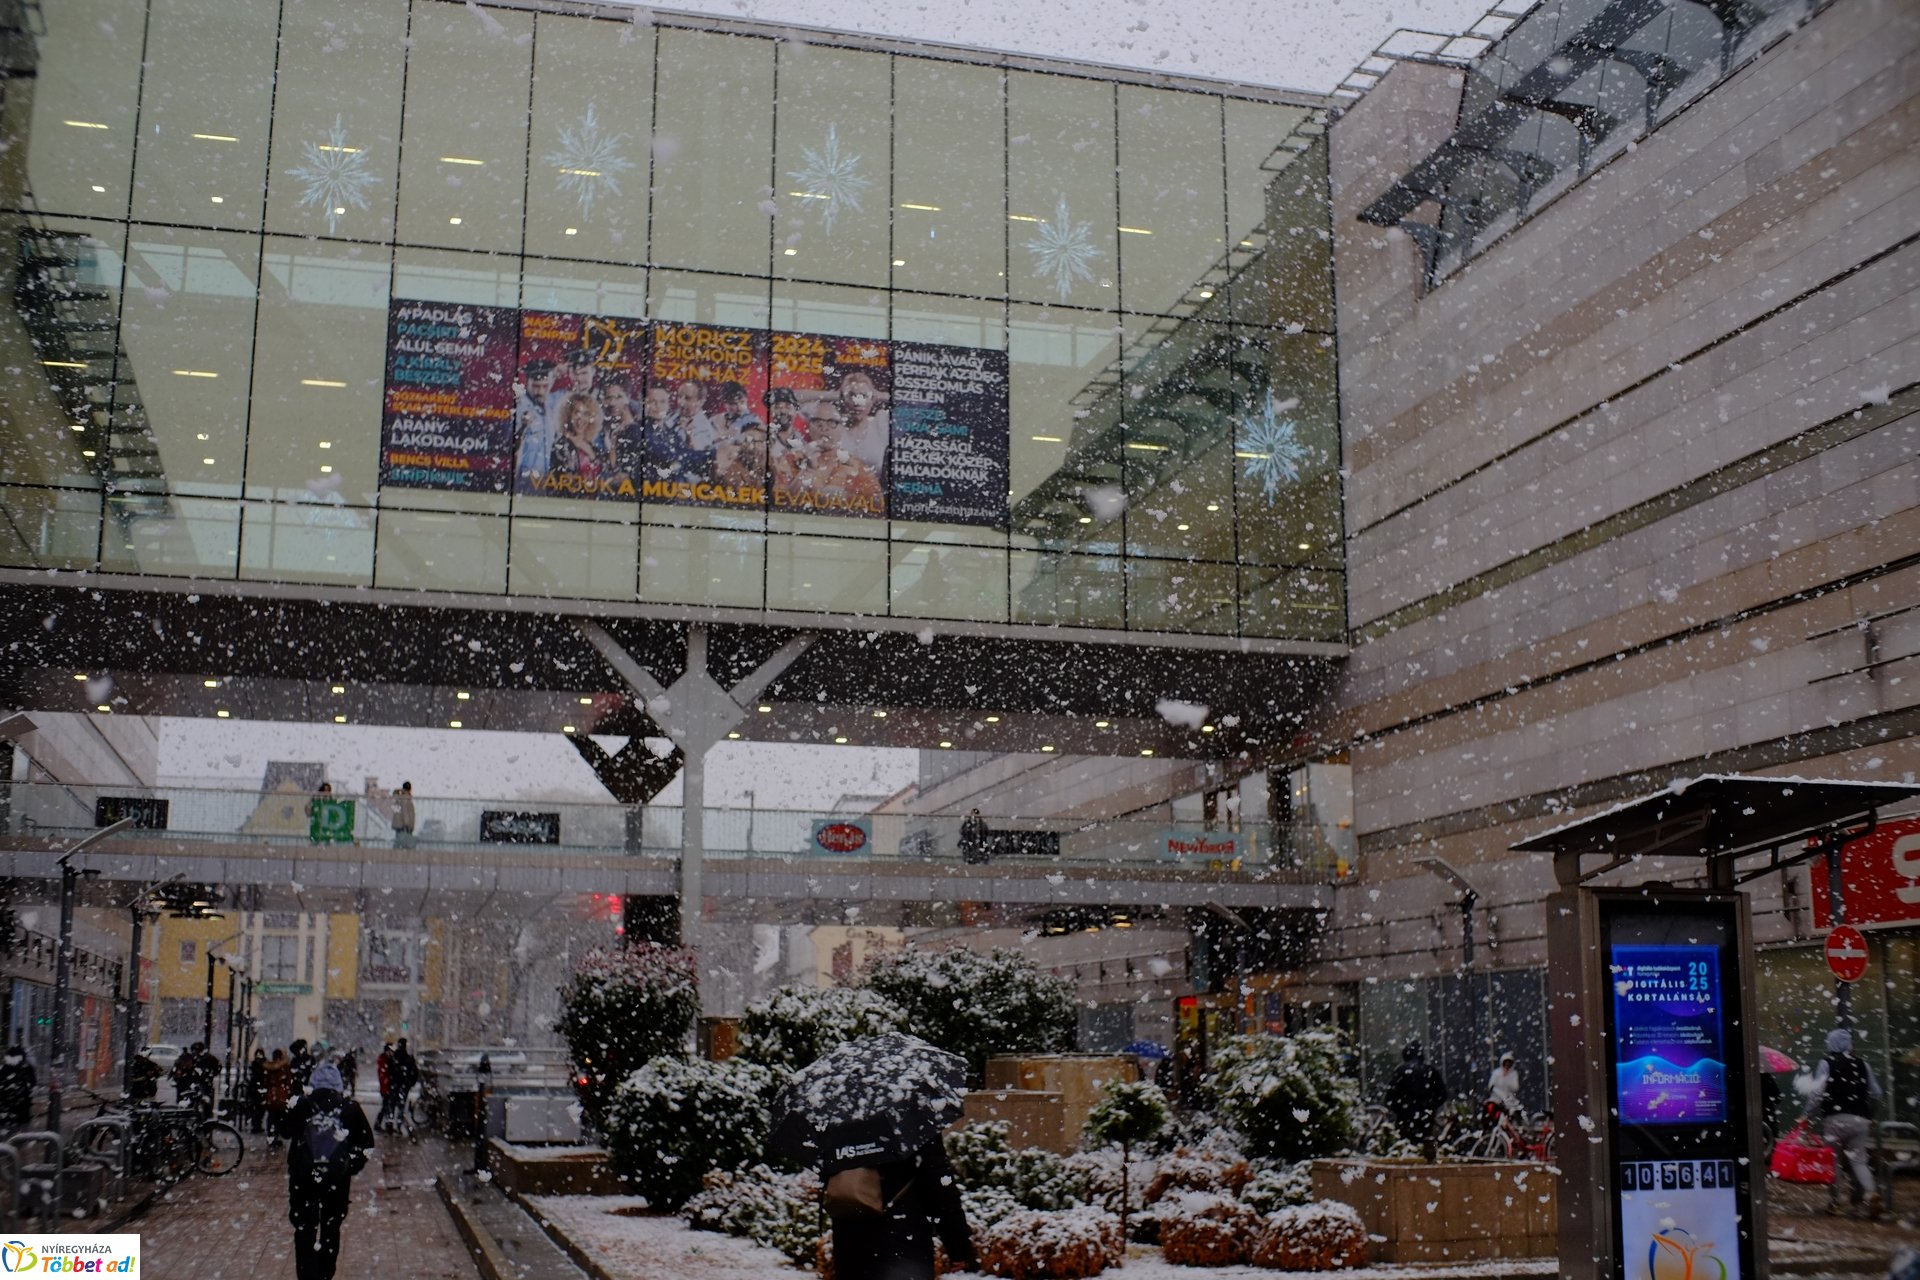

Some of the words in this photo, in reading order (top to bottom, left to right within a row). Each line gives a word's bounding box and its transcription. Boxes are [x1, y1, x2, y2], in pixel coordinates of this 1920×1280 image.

[437, 342, 486, 358] SEMMI
[655, 345, 752, 365] ZSIGMOND
[895, 362, 949, 379] FÉRFIAK
[895, 388, 945, 403] SZÉLÉN
[391, 432, 489, 450] LAKODALOM
[895, 437, 972, 453] HÁZASSÁGI
[435, 455, 469, 468] VILLA
[895, 450, 946, 465] LECKÉK
[895, 465, 990, 481] HALADÓKNAK
[618, 479, 636, 496] A
[642, 480, 767, 505] MUSICALEK
[895, 481, 943, 496] YERMA
[1688, 961, 1708, 976] 20
[1689, 976, 1708, 990] 25
[1624, 1165, 1730, 1185] 10:56:41
